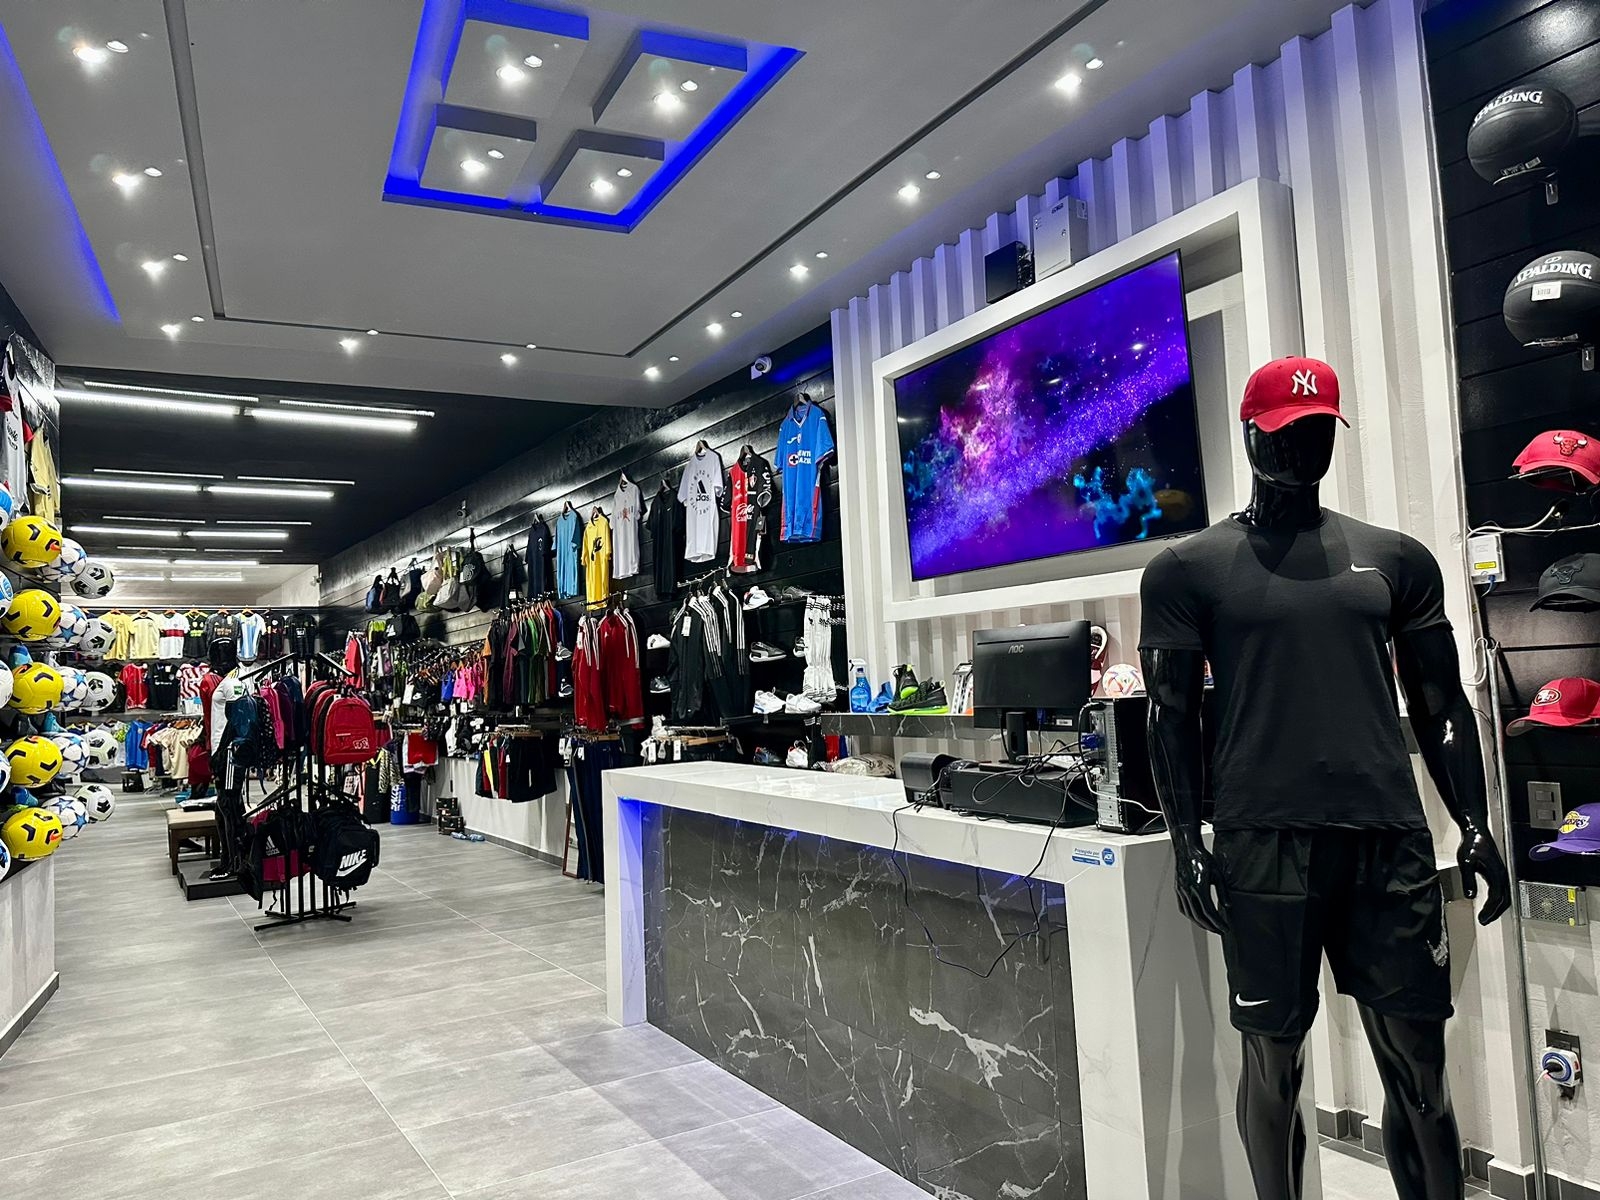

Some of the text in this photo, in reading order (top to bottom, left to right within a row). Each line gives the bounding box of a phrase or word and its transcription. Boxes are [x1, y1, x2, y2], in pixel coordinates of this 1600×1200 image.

[1472, 90, 1543, 128] SPALDING
[1514, 262, 1592, 287] SPALDING
[339, 849, 367, 869] NIKE
